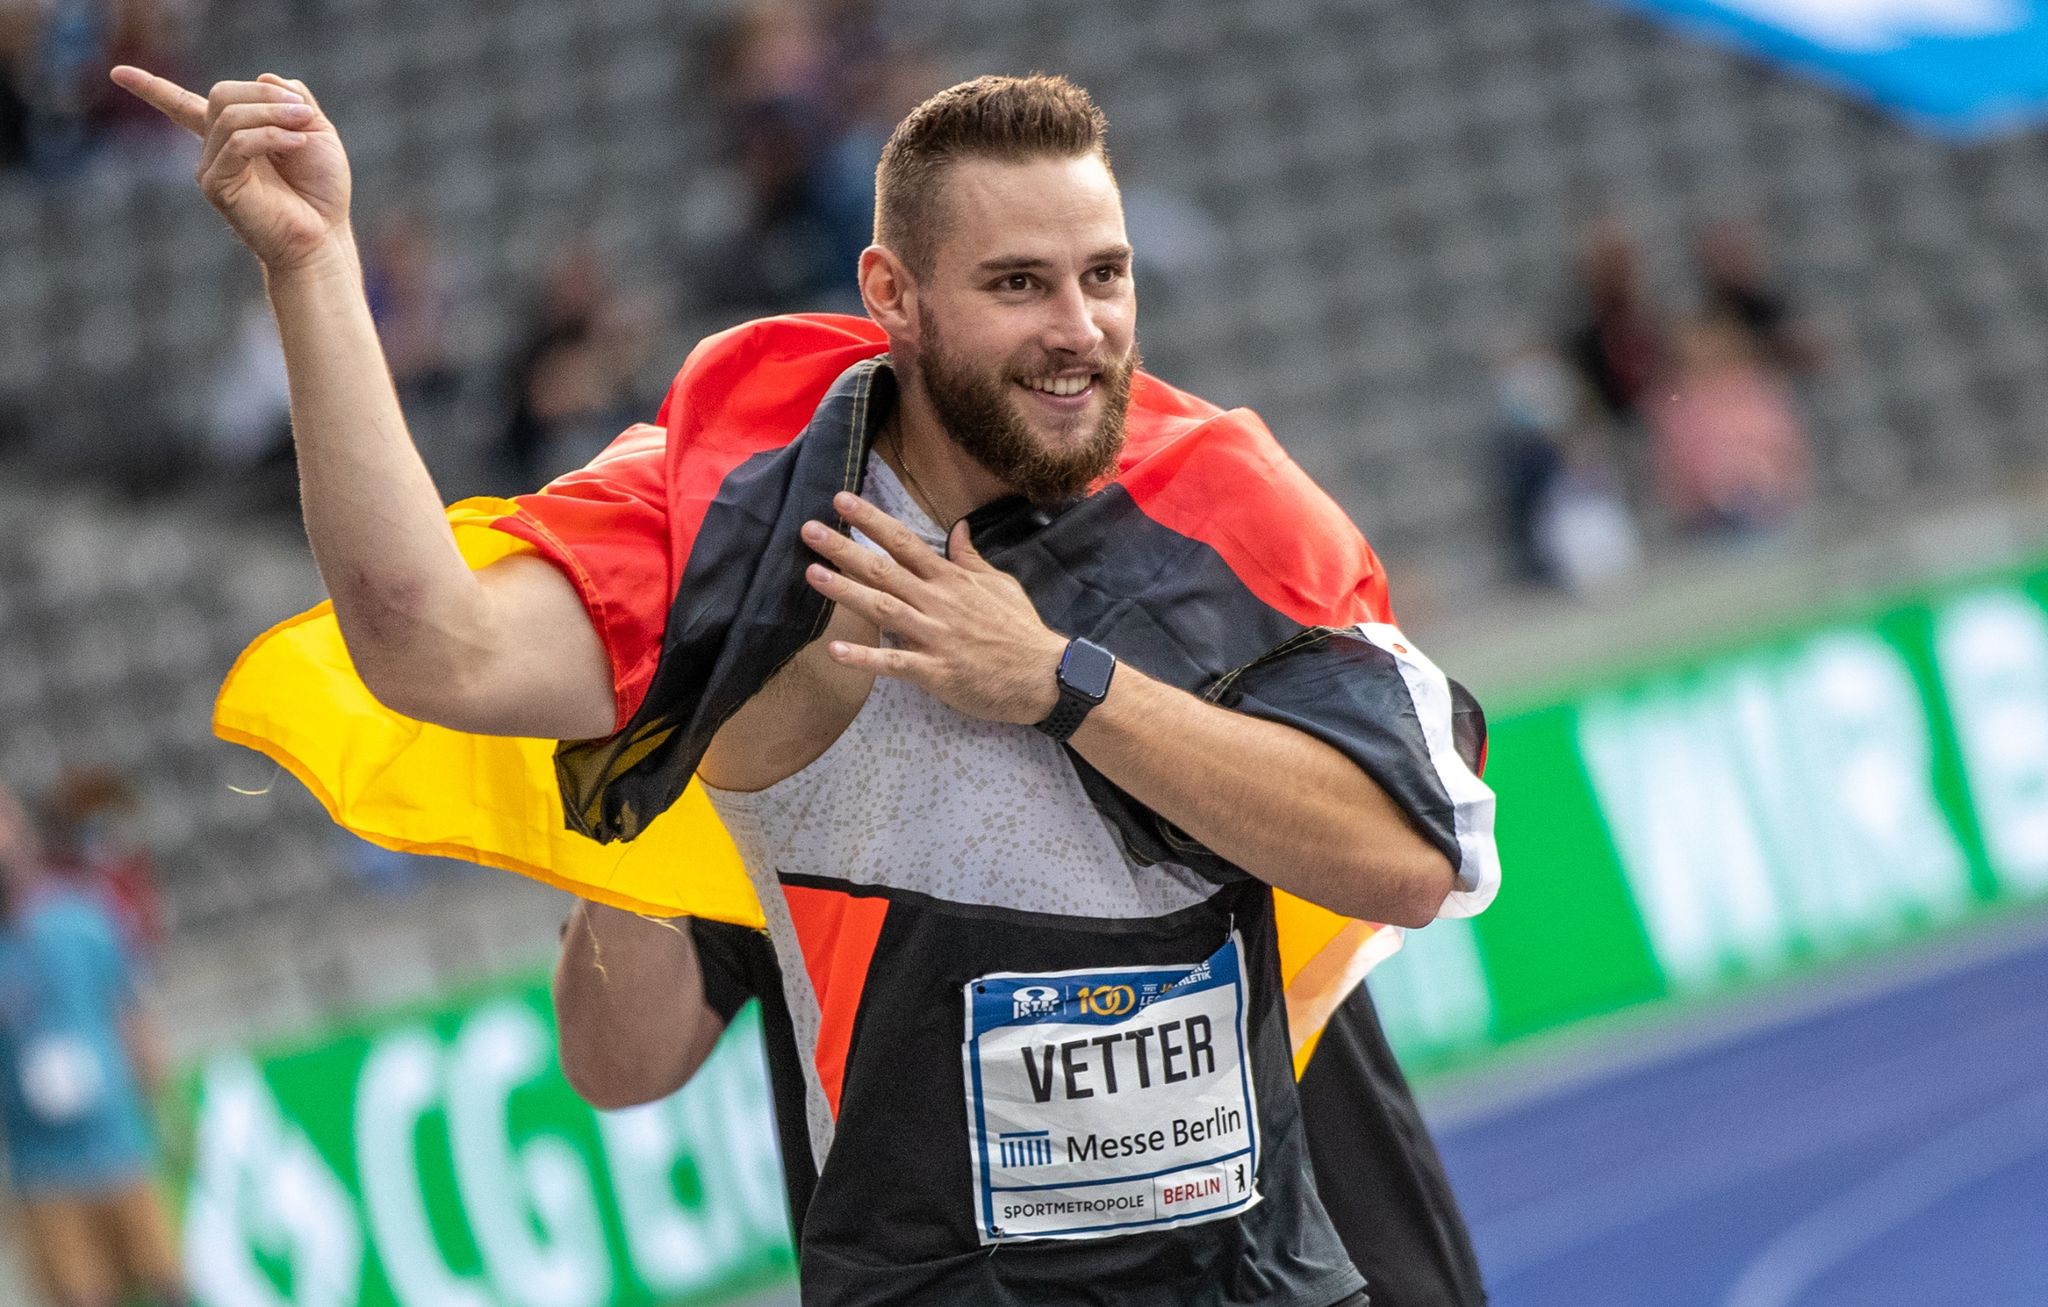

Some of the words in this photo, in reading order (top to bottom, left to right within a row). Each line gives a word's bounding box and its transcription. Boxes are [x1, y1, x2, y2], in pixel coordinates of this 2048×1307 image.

[1077, 984, 1136, 1016] 100
[1021, 1014, 1215, 1103] VETTER
[1066, 1128, 1165, 1163] Messe
[1171, 1106, 1241, 1147] Berlin
[1004, 1194, 1144, 1220] SPORTMETROPOLE
[1163, 1177, 1221, 1205] BERLIN
